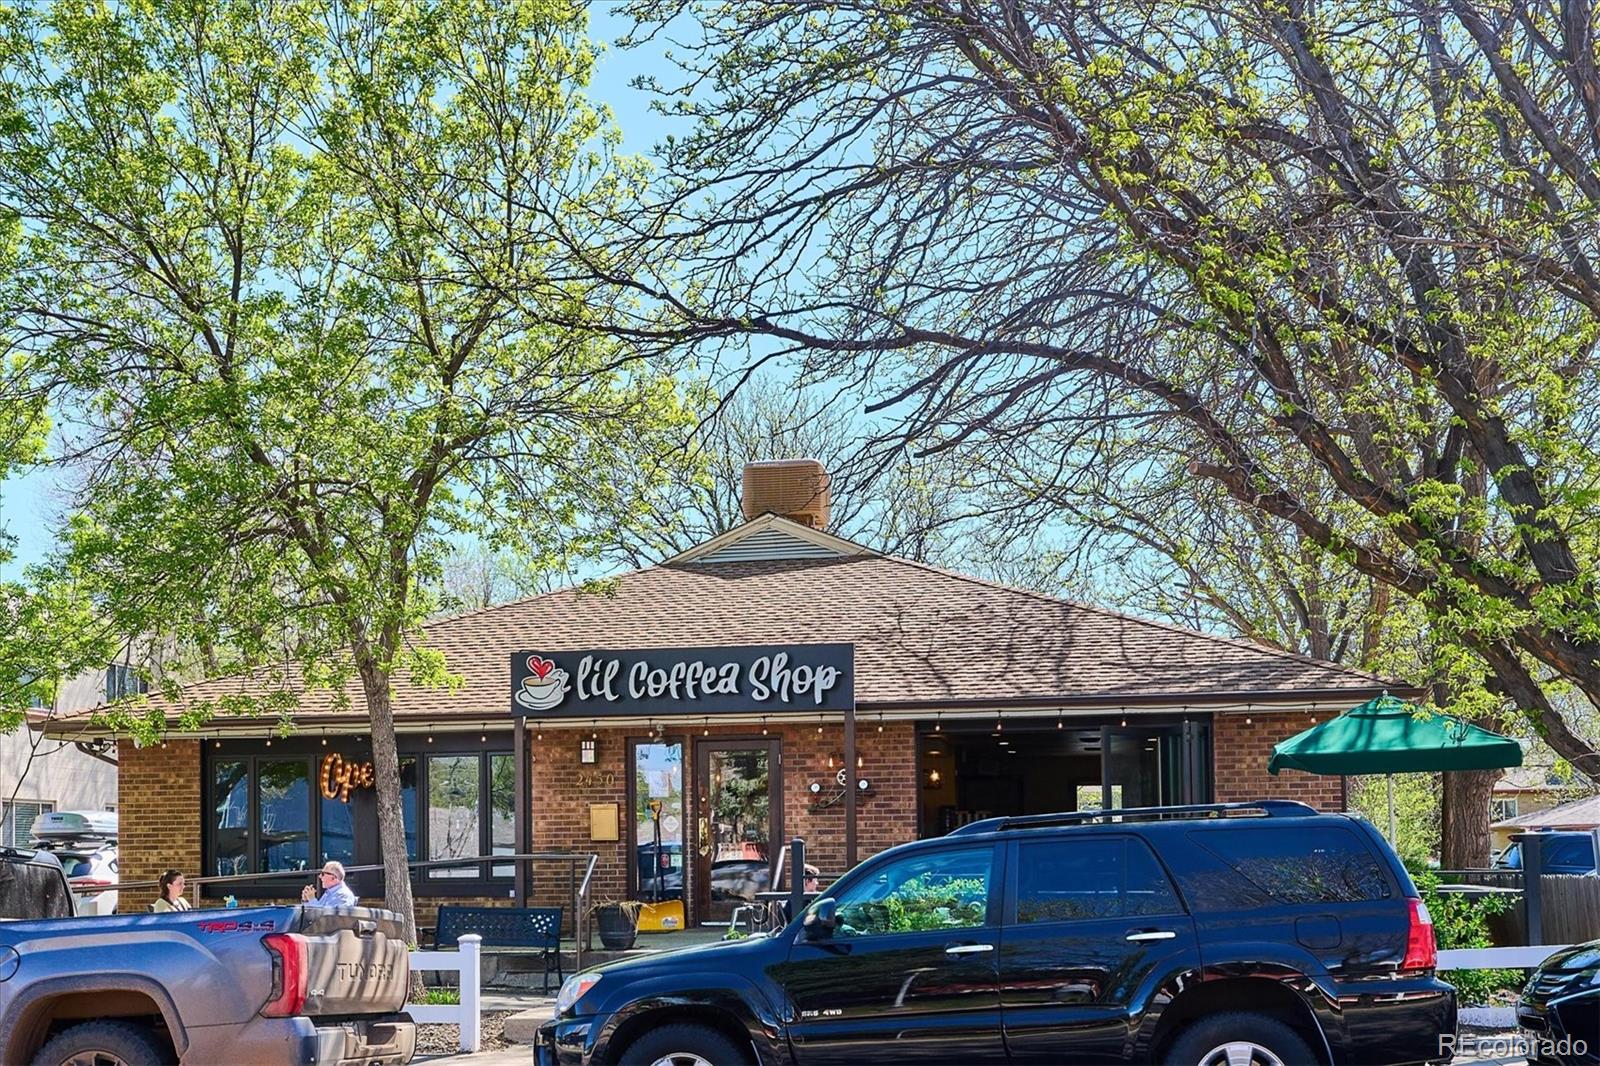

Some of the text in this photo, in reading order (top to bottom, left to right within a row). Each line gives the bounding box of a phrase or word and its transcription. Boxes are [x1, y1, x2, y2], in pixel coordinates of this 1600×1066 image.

[577, 651, 842, 705] lil Coffea Shop
[320, 753, 375, 803] Ope
[822, 1008, 842, 1016] 4WD
